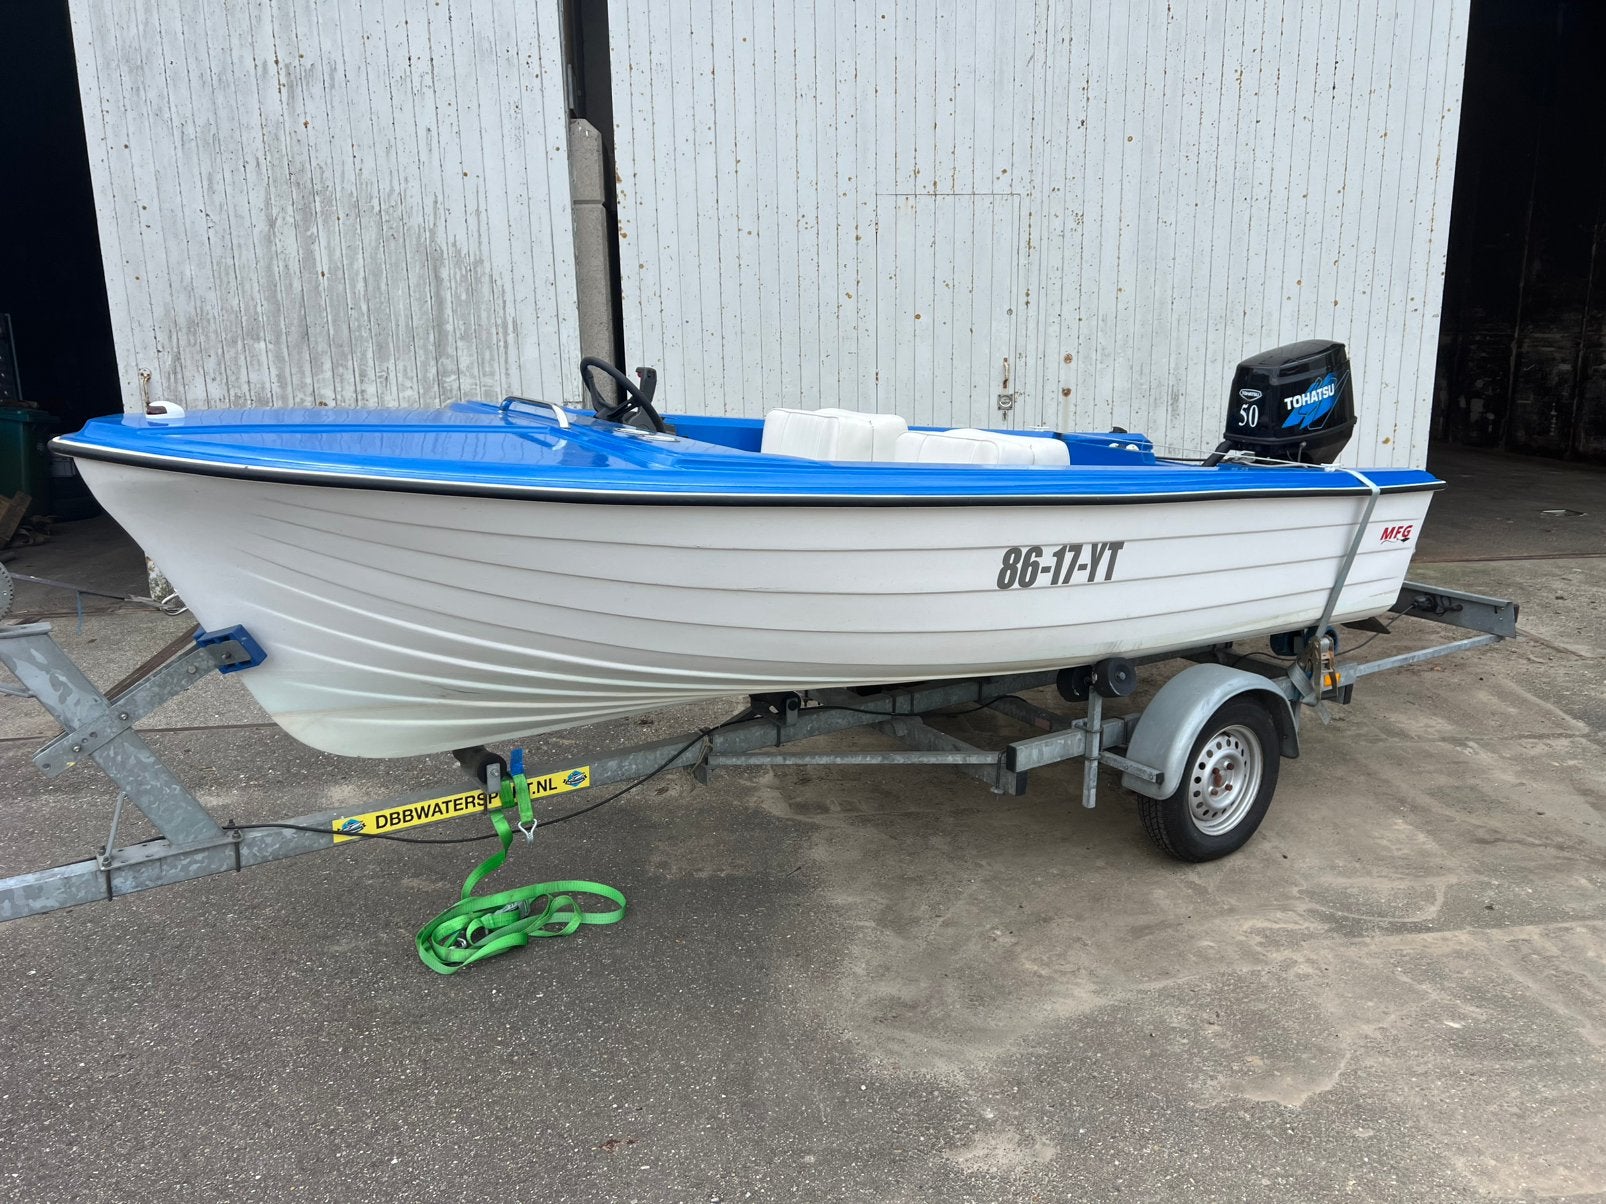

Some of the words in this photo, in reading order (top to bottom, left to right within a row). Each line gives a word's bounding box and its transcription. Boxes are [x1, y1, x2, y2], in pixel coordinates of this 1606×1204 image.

[1284, 383, 1335, 410] TOHATSU
[1238, 404, 1259, 427] 50
[1380, 525, 1413, 540] MFG
[996, 541, 1125, 590] 86-17-YT
[375, 778, 558, 830] DBBWATERSPT.NL
